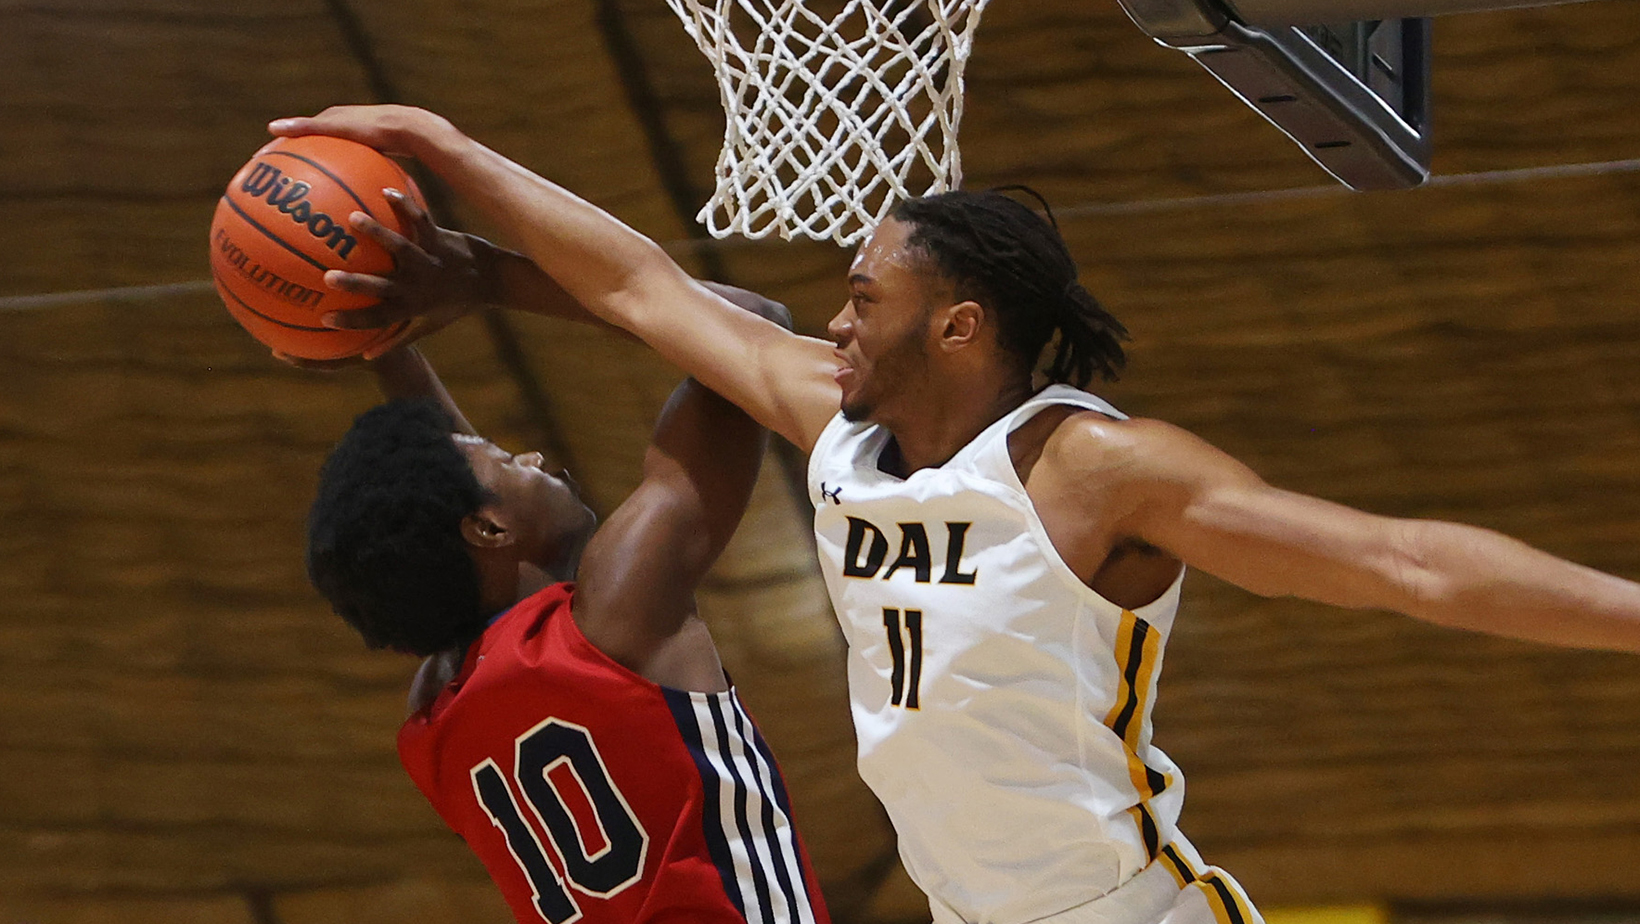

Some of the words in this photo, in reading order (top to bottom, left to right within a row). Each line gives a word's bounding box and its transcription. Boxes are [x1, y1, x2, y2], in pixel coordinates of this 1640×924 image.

[242, 162, 358, 259] Wilson
[843, 515, 978, 586] DAL
[882, 606, 923, 711] 11
[470, 716, 650, 924] 10
